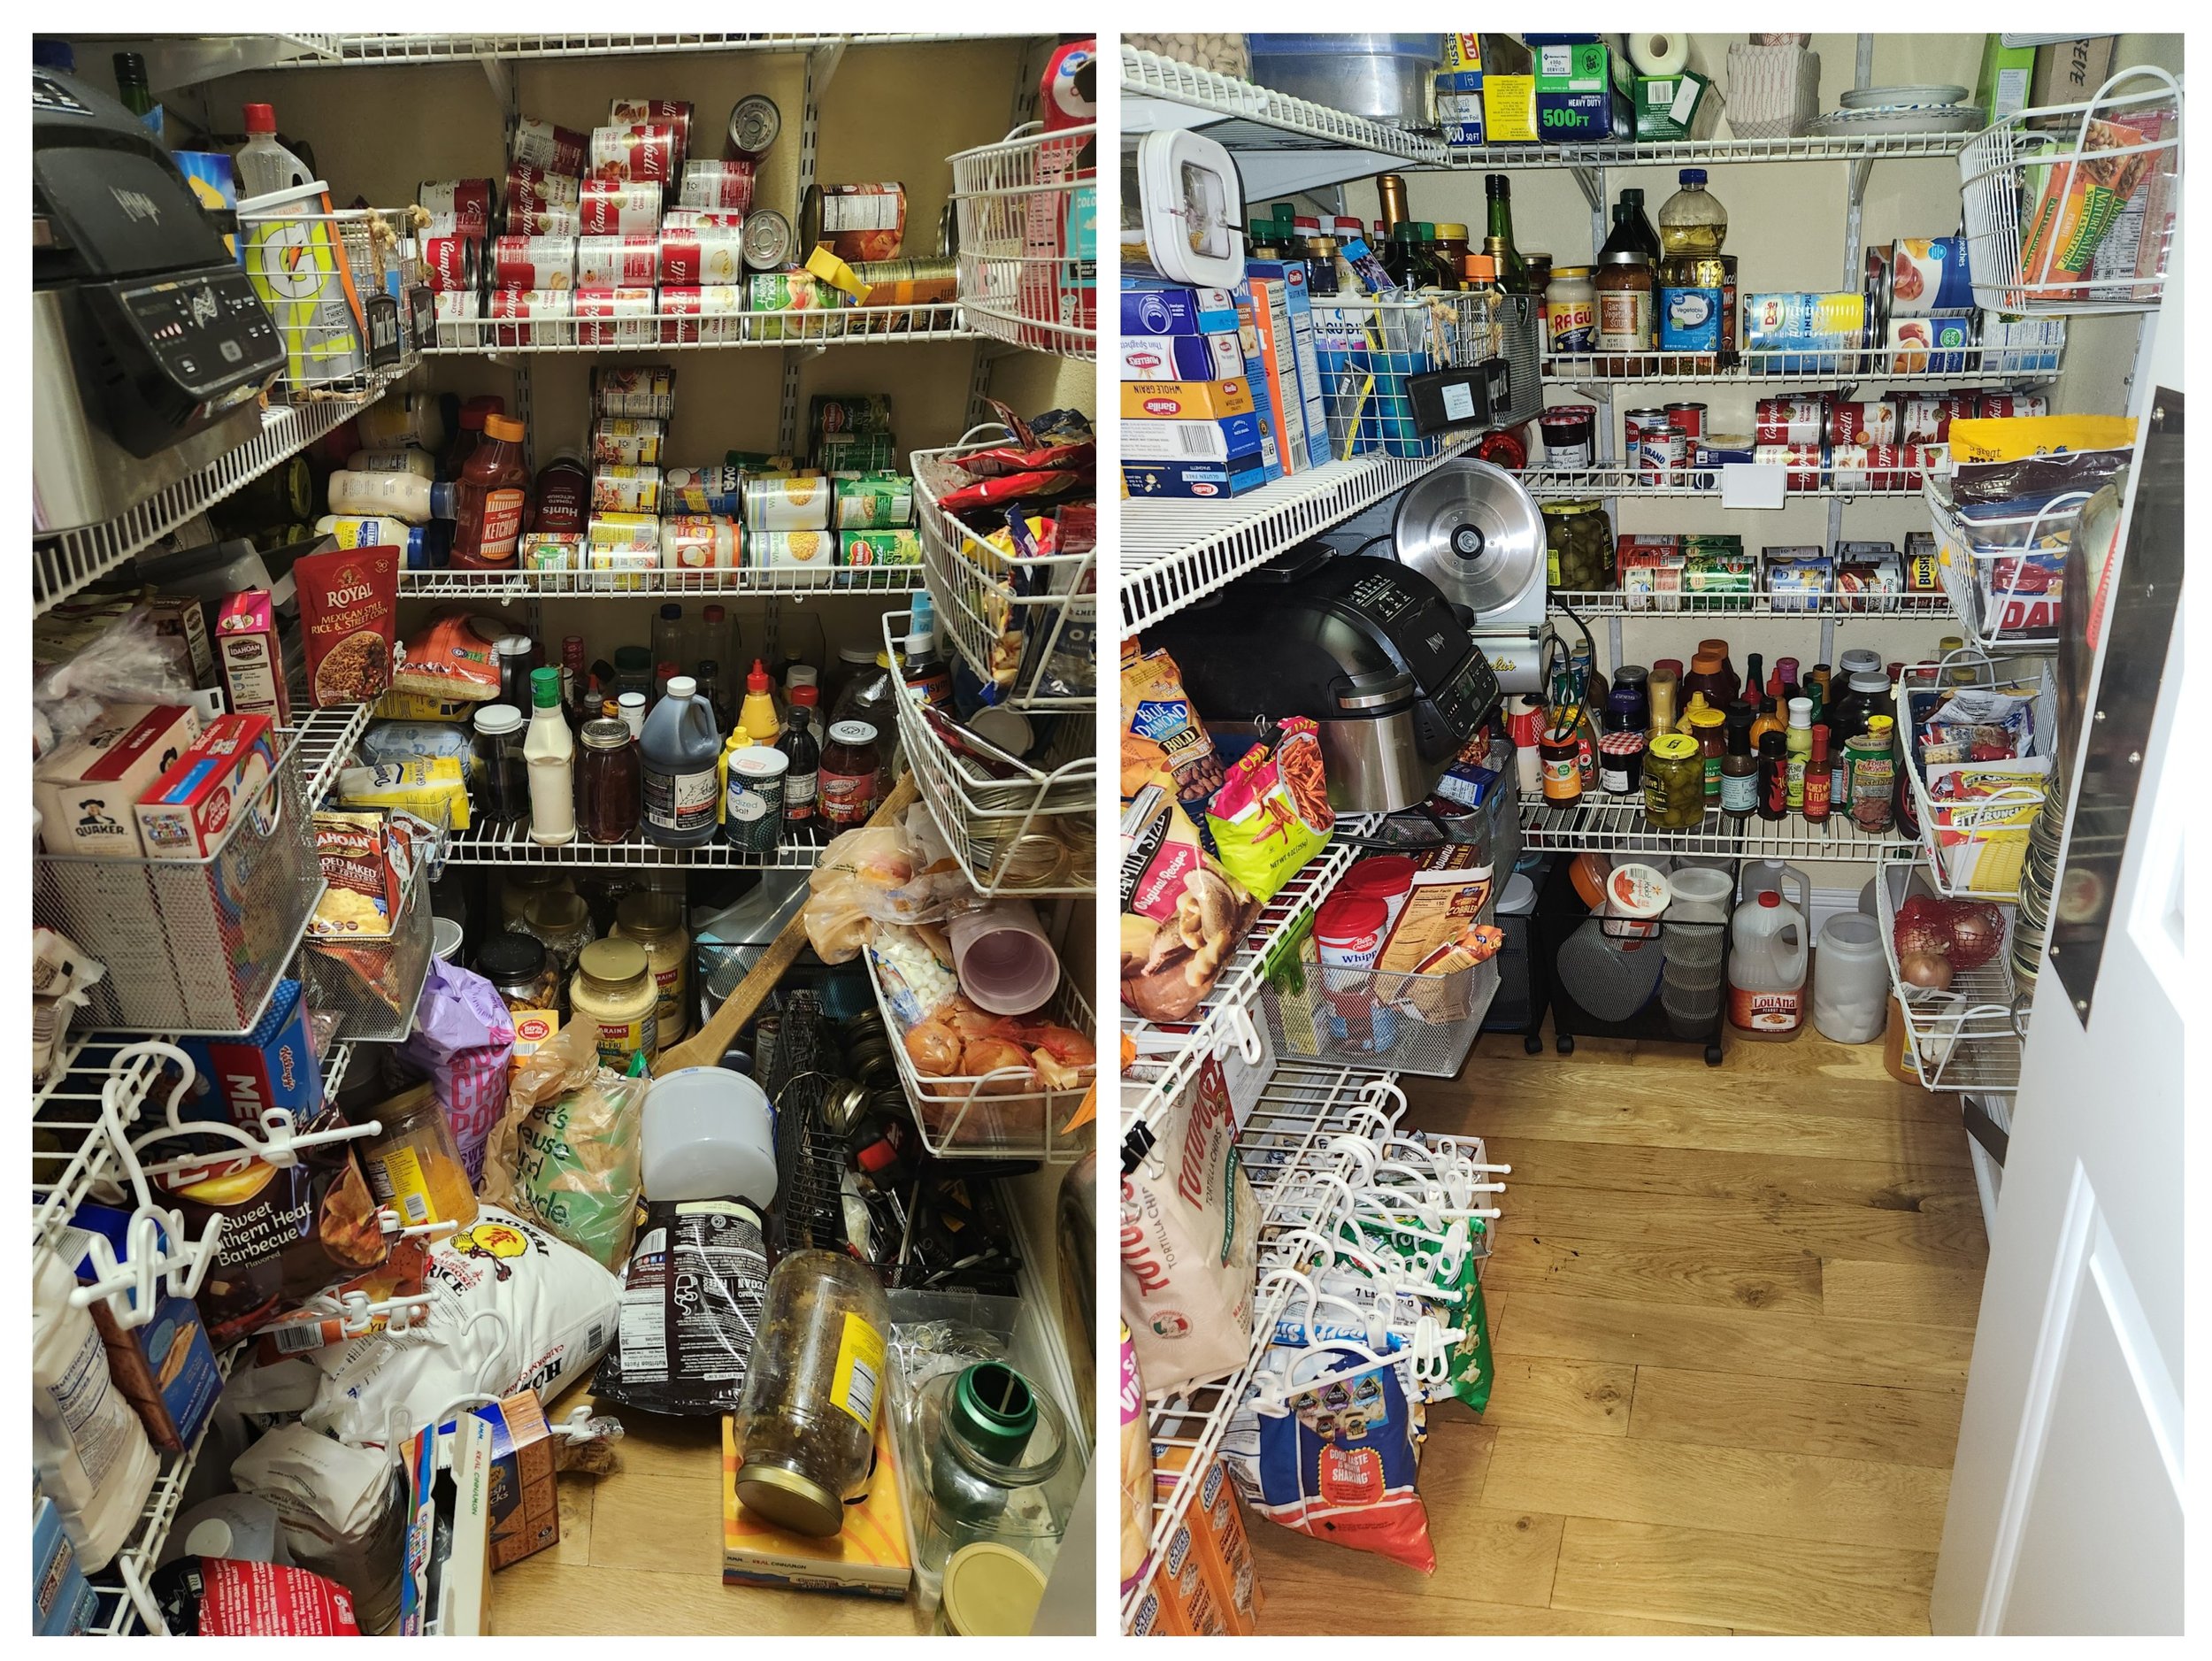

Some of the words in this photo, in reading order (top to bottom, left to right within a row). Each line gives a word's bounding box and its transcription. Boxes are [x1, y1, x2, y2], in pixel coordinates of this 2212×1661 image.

[1568, 98, 1585, 107] HEAVY
[1586, 98, 1601, 107] DUTY
[1466, 133, 1473, 142] SQ
[1473, 132, 1480, 142] FT
[643, 125, 660, 175] ampbell's
[2083, 189, 2094, 215] SWEET
[2086, 188, 2115, 232] NATURE
[2061, 212, 2076, 238] PEANUT
[2070, 223, 2085, 250] SALTY
[2065, 232, 2095, 273] VALLEY
[1133, 385, 1153, 394] GRAIN
[1154, 385, 1182, 394] WHOLE
[1146, 402, 1177, 412] Barilla
[1840, 411, 1854, 444] mpbell's
[1645, 447, 1666, 465] BRAND
[485, 518, 518, 540] KETCHUP
[326, 582, 373, 609] ROYAL
[311, 625, 333, 634] RICE
[334, 622, 343, 632] &
[344, 614, 369, 629] STREET
[370, 607, 388, 619] CORN
[321, 609, 363, 625] MEXICAN
[364, 601, 382, 614] STYLE
[229, 644, 260, 656] IDAHOAN
[1134, 704, 1188, 739] DIAMOND
[1137, 703, 1169, 722] BLUE
[1164, 729, 1197, 752] BOLD
[1172, 760, 1197, 778] FLAVORED
[734, 804, 749, 816] Salt
[76, 825, 124, 838] QUAKER
[317, 834, 369, 848] AHOAN
[1143, 814, 1166, 849] SIZE
[347, 860, 377, 878] BAKED
[1270, 860, 1279, 870] NET
[1133, 876, 1169, 911] Original
[1164, 849, 1187, 882] Recipe
[1445, 904, 1479, 918] COBBLER
[1352, 940, 1377, 951] Crocker
[1356, 934, 1372, 945] Betty
[1754, 996, 1796, 1009] LouAna
[280, 1045, 296, 1091] Kellogg's
[1179, 1088, 1222, 1211] TOTOPOS
[1210, 1126, 1222, 1163] CHIPS
[1205, 1166, 1217, 1207] TORTILLA
[1227, 1157, 1236, 1195] MEXICAN
[222, 1202, 273, 1233] Sweet
[271, 1201, 312, 1229] Heat
[1225, 1196, 1234, 1237] AUTHENTIC
[219, 1227, 299, 1267] Barbecue
[1153, 1219, 1176, 1270] TORTILLA
[244, 1250, 281, 1270] Flavored
[428, 1264, 469, 1297] RICE
[50, 1350, 86, 1396] Nutrition
[623, 1359, 640, 1368] Facts
[640, 1358, 667, 1368] Nutrition
[61, 1382, 91, 1411] Calories
[472, 1450, 482, 1472] REAL
[1330, 1449, 1347, 1462] GOOD
[1348, 1452, 1370, 1466] TASTE
[1332, 1468, 1369, 1485] SHARING
[471, 1472, 480, 1516] CINNAMON
[771, 1560, 807, 1571] CINNAMON
